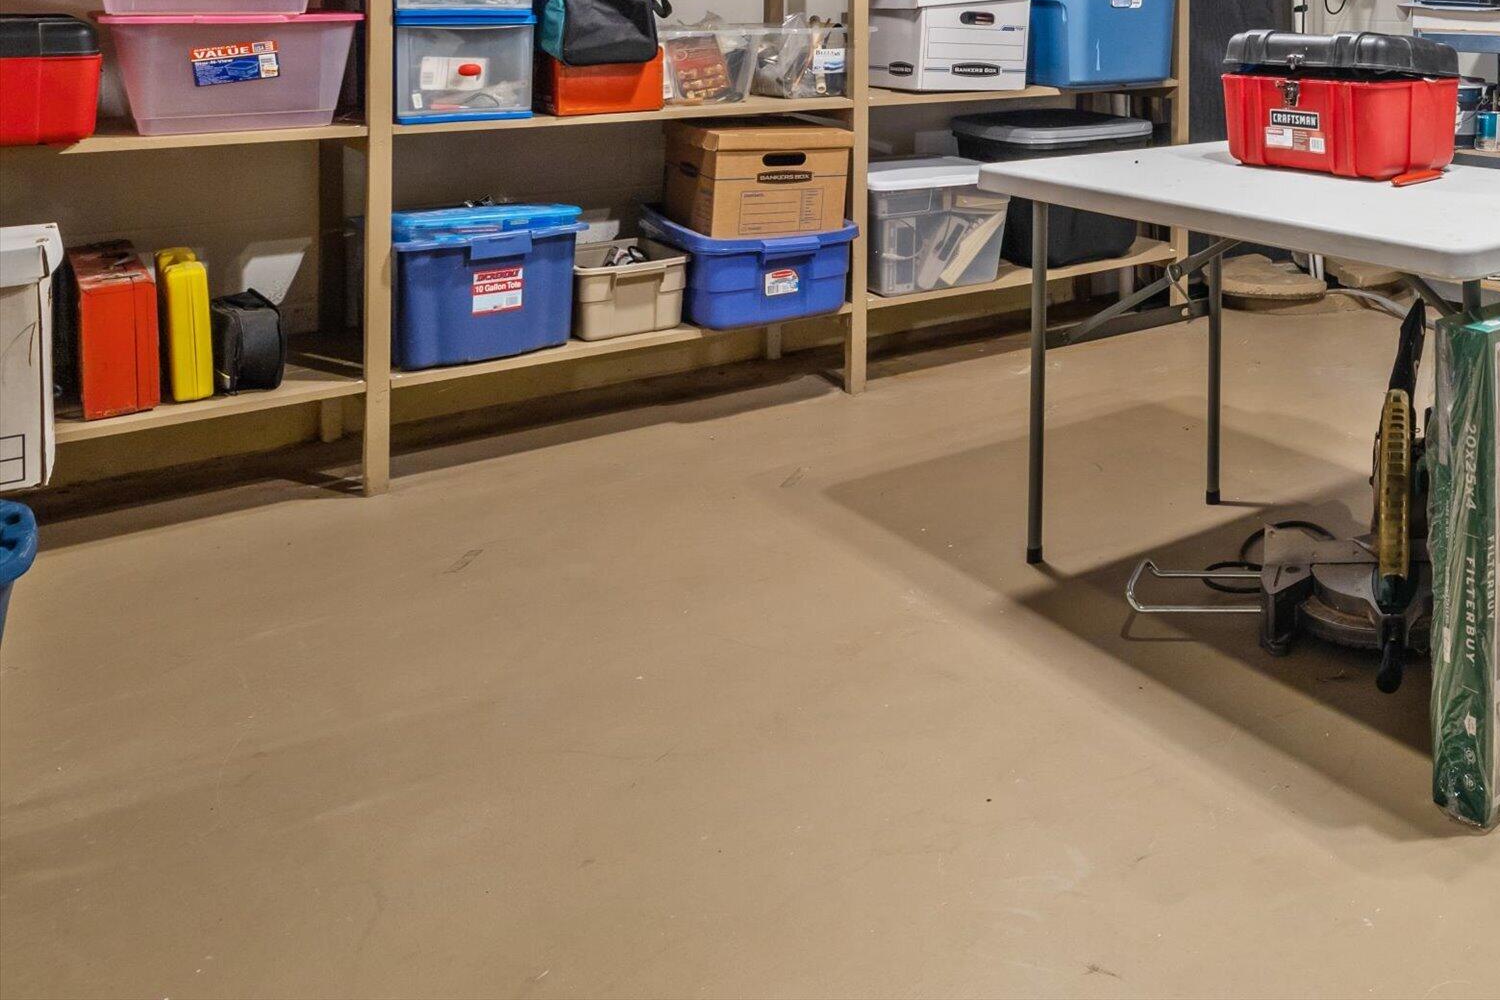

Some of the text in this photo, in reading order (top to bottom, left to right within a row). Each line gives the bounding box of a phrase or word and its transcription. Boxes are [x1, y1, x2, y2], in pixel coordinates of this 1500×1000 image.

[193, 46, 250, 59] VALUE
[1272, 113, 1317, 126] CRAFTSMAN
[475, 281, 522, 293] 10 Gallon Tote
[1487, 534, 1495, 620] FILTERBUY
[1465, 556, 1477, 664] FILTERBUY
